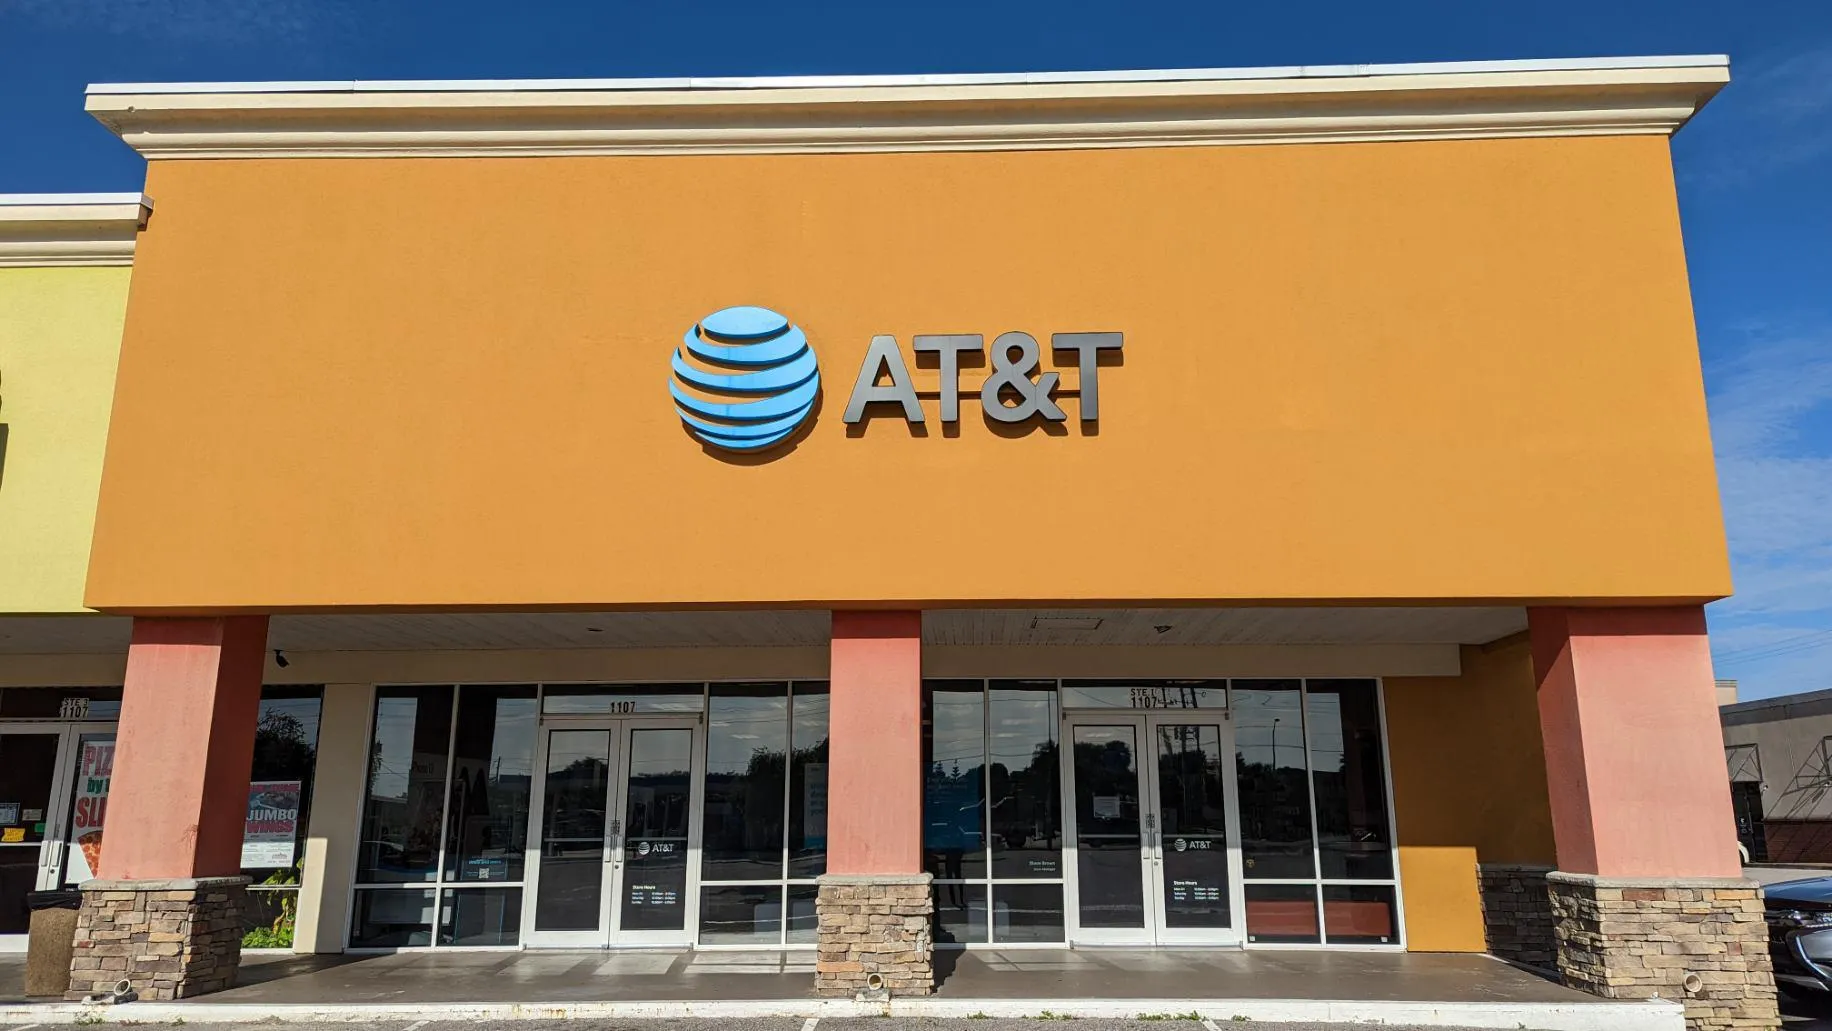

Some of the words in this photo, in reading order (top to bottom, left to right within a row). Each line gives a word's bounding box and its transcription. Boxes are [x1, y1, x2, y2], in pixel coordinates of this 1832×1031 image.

[841, 331, 1124, 424] AT&T
[611, 701, 636, 713] 1107
[1131, 696, 1157, 709] 1107
[62, 706, 89, 718] 1107
[82, 745, 116, 777] PIZ
[75, 796, 108, 829] SLI
[247, 808, 298, 821] JUMBO
[245, 820, 295, 834] WINGS
[652, 843, 675, 852] AT&T
[1189, 840, 1212, 849] AT&T
